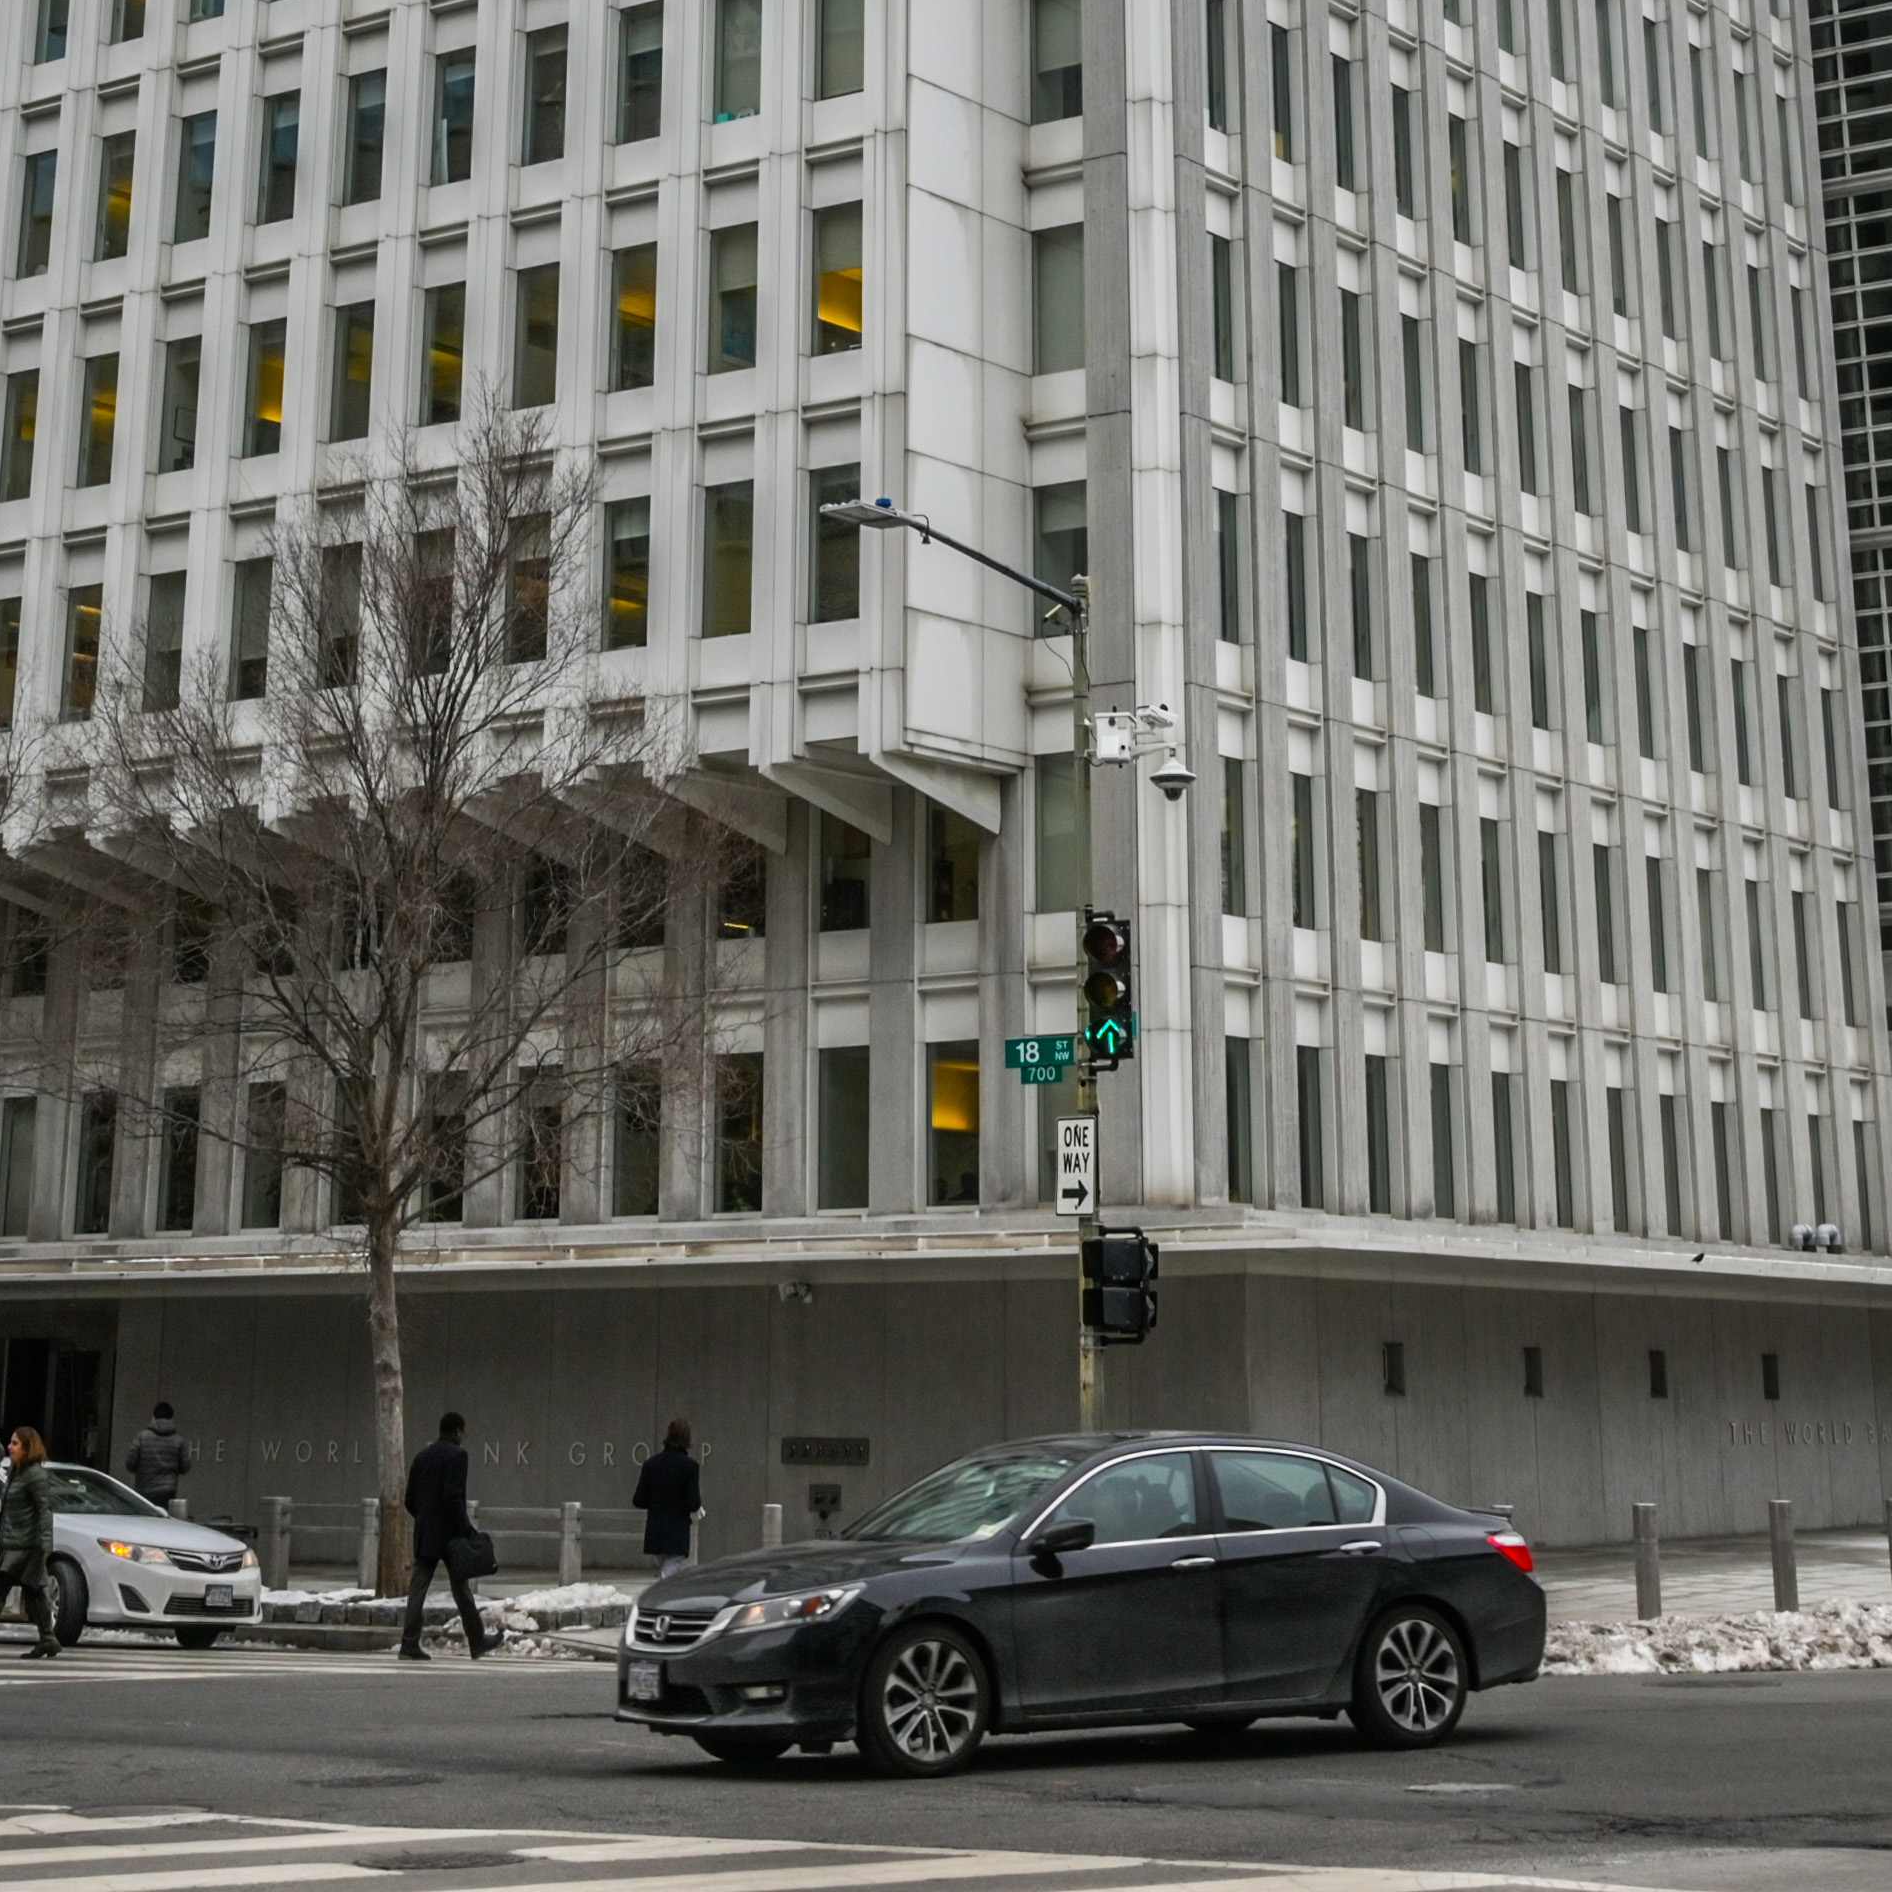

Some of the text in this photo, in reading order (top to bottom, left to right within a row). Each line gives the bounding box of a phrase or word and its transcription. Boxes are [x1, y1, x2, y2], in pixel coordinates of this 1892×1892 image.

[1015, 1041, 1040, 1063] 18
[1055, 1040, 1068, 1050] ST
[1054, 1051, 1070, 1061] NW
[1027, 1065, 1056, 1082] 700
[1064, 1125, 1089, 1147] ONE
[1063, 1152, 1090, 1173] WAY
[1728, 1421, 1769, 1445] THE
[1784, 1421, 1854, 1445] WORLD
[186, 1439, 227, 1463] HE
[261, 1439, 364, 1464] WORL
[568, 1441, 713, 1467] GROP
